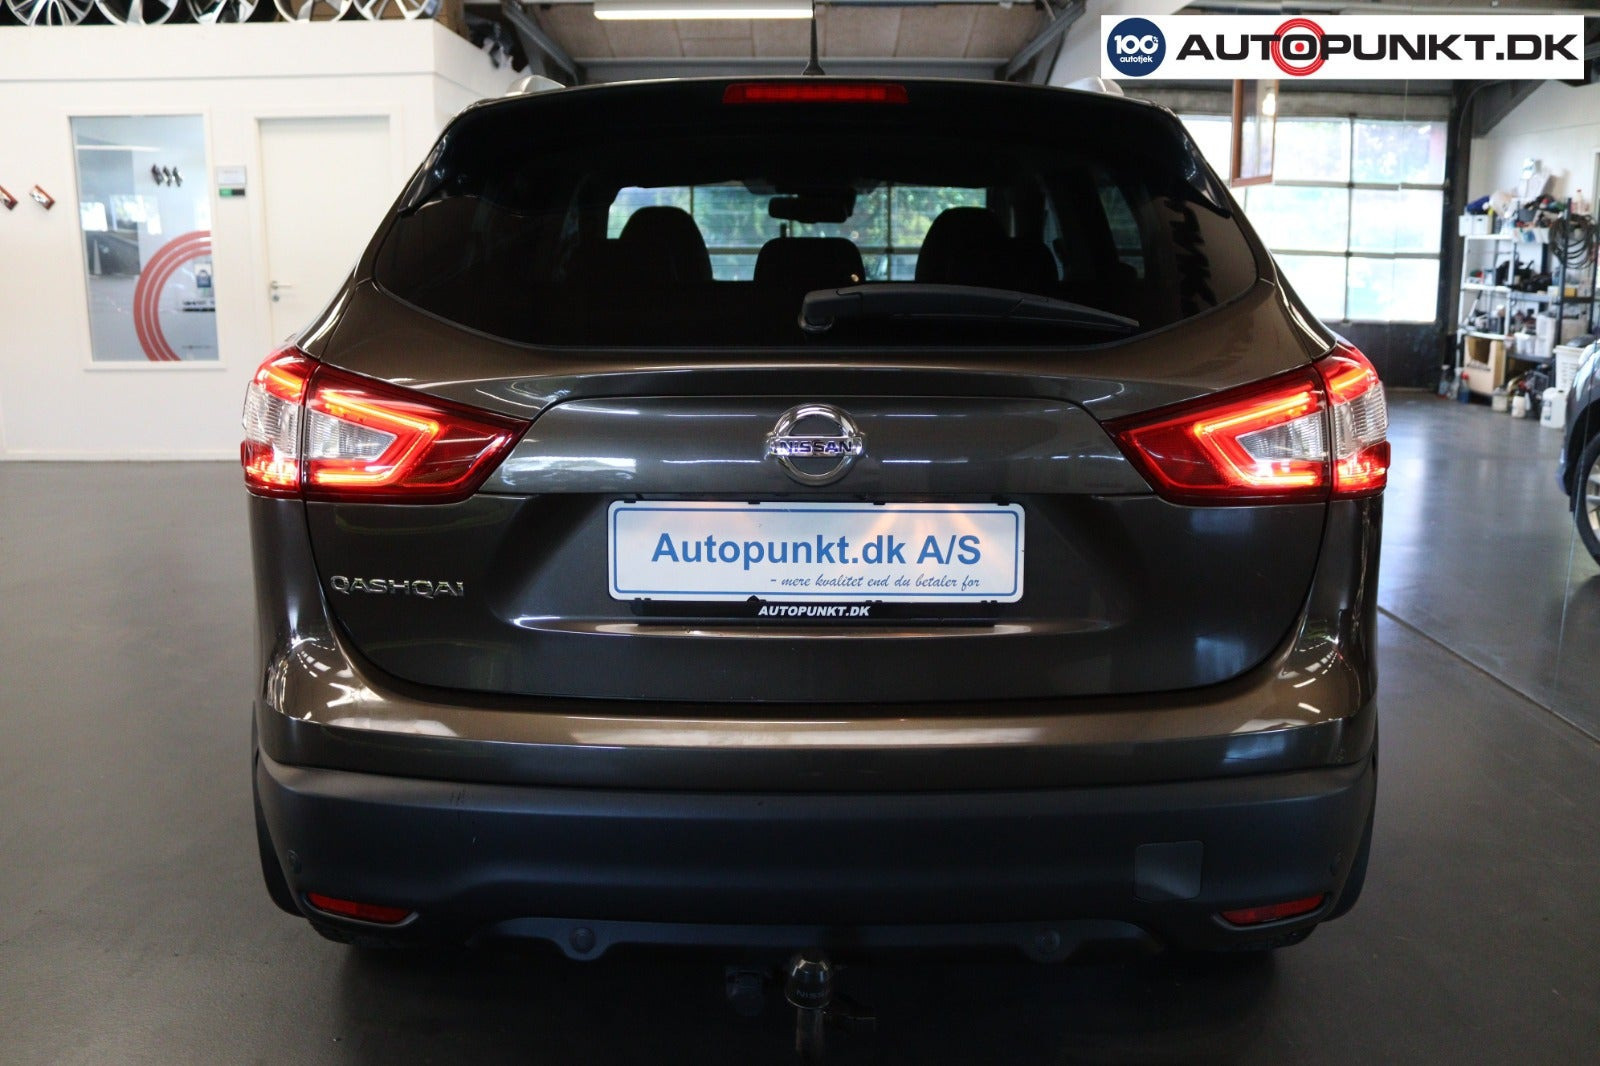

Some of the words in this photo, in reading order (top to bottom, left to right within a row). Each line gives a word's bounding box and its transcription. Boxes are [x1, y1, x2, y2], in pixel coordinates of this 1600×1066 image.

[778, 440, 852, 453] NISSAN
[651, 532, 907, 571] Autopunkt.dk
[916, 534, 982, 565] A/S
[330, 575, 465, 599] QASHQAI
[781, 577, 811, 587] mere
[815, 573, 864, 588] kvalitet
[867, 574, 891, 588] end
[894, 574, 911, 588] du
[915, 573, 958, 588] betaler
[961, 574, 981, 592] for
[757, 605, 871, 618] AUTOPUNKT.DK
